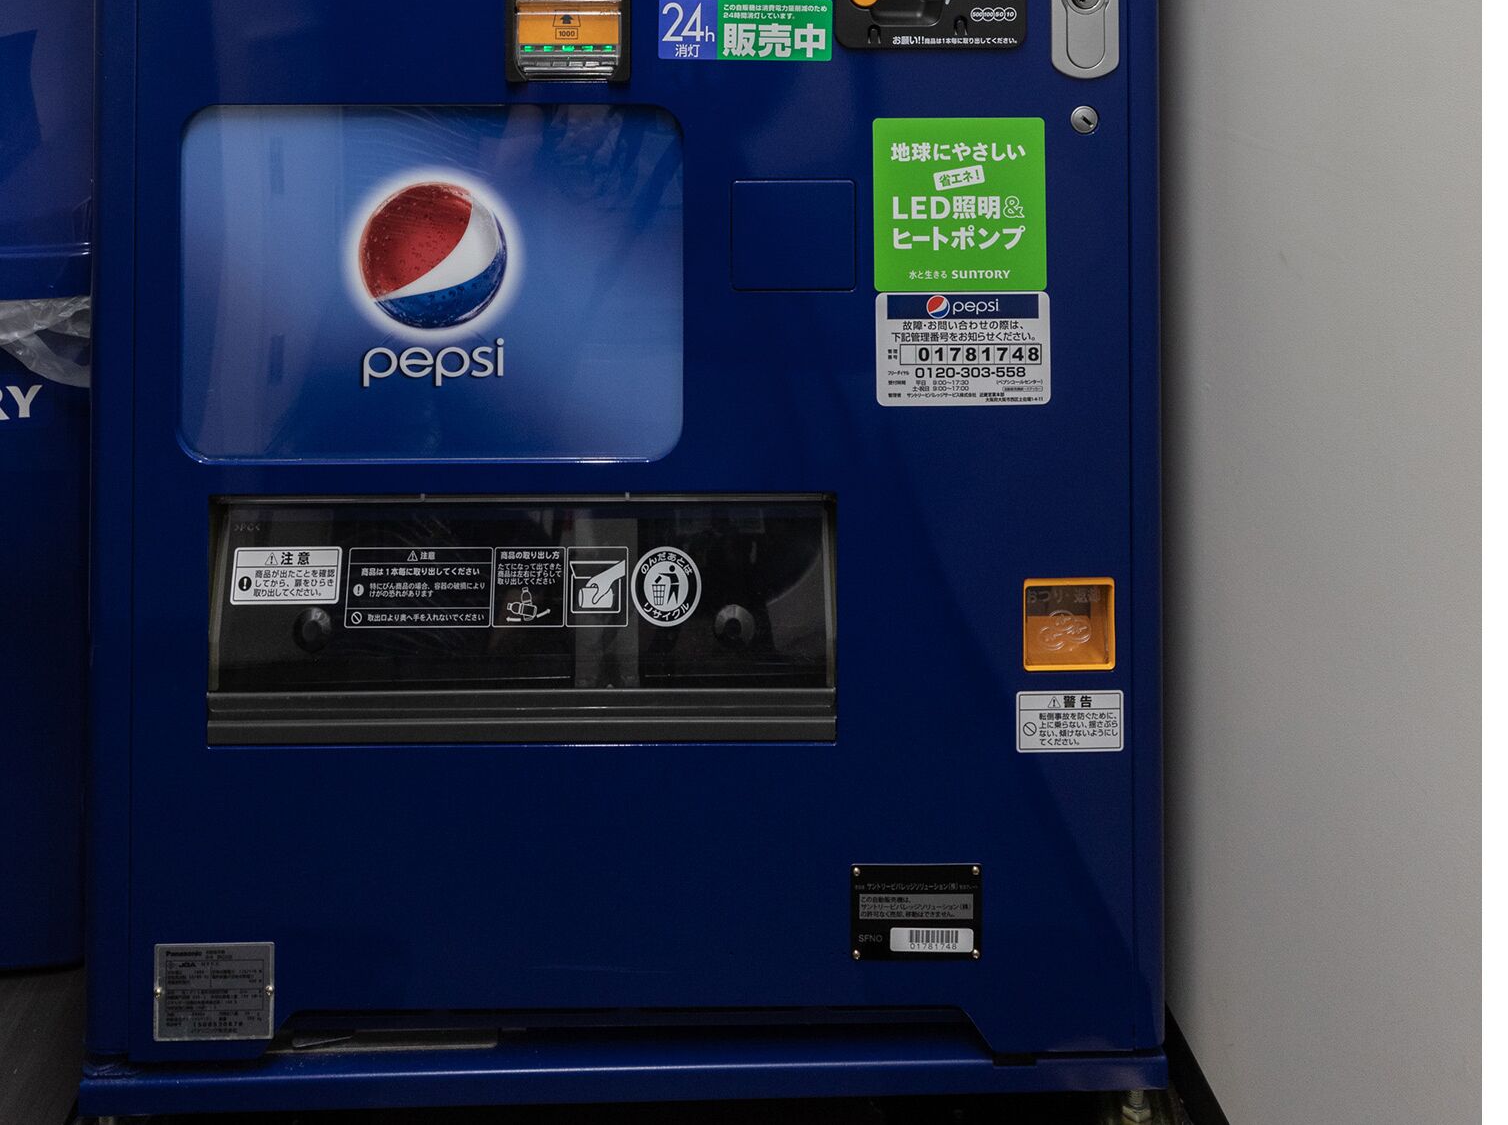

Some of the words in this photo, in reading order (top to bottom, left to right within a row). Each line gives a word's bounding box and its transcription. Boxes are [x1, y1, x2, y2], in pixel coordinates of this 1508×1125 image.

[723, 23, 826, 58] 販売中
[675, 44, 700, 58] 消灯
[891, 143, 1026, 162] 地球にやさしい
[939, 168, 982, 188] 省エネ!
[893, 225, 1026, 251] ヒートポンプ
[909, 270, 948, 280] 水と生きる
[951, 270, 1010, 279] SUNTORY
[953, 299, 999, 315] pepsi
[903, 321, 1024, 330] 故障・お問い合わせの際は、
[892, 332, 1036, 342] 下記管理番号をお知らせください。
[918, 347, 1039, 362] 01781748
[361, 337, 505, 389] pepsi
[915, 367, 1026, 378] 0120-303-558
[280, 552, 311, 565] 注意
[500, 551, 560, 560] 商品の取り出し方
[498, 563, 562, 571] たてになって出てきた
[640, 551, 693, 575] のんだあとは
[255, 570, 335, 579] 商品が出たことを確認
[497, 570, 561, 578] 商品は左右にずらして
[255, 578, 334, 588] してから、扉をひらき
[497, 577, 556, 585] 取り出してください
[253, 588, 323, 597] 取り出してください。
[643, 601, 690, 622] リサイクル
[1063, 696, 1092, 708] 警告
[1039, 721, 1118, 729] 上に乗らない、揺さぶら
[1039, 738, 1080, 746] てください。
